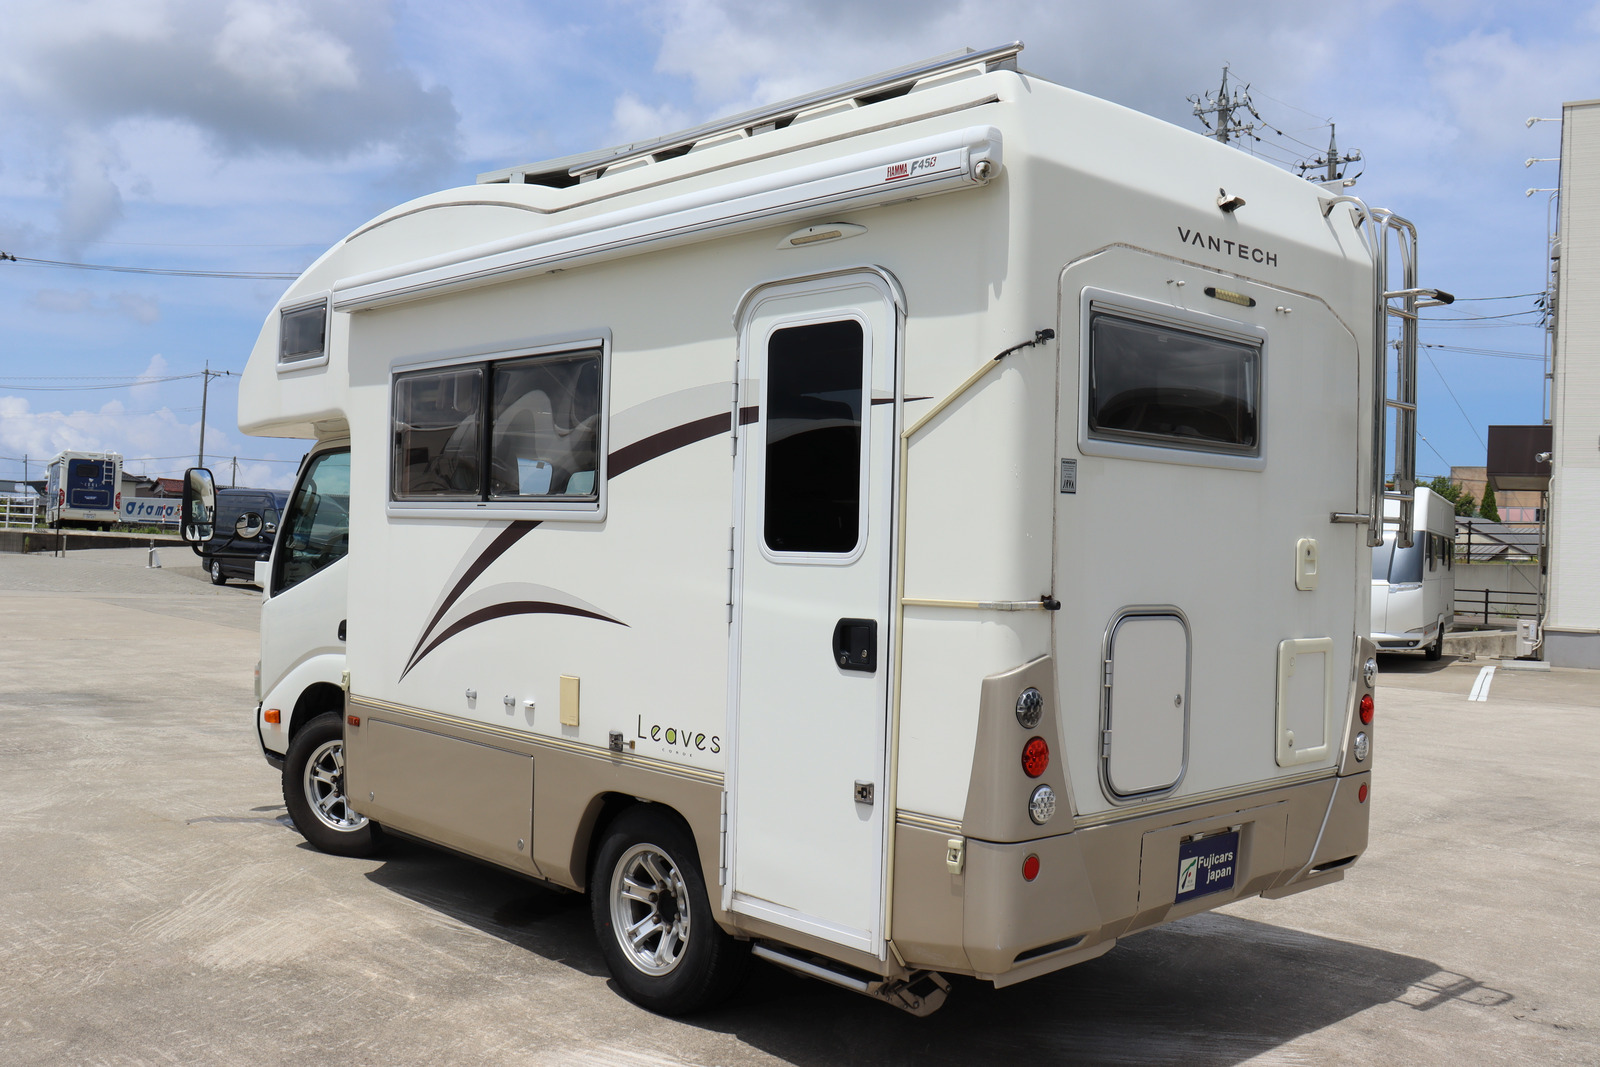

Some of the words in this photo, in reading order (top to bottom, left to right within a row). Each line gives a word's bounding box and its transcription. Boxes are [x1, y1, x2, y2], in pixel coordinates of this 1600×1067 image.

[887, 163, 908, 178] FIAMMA
[1178, 226, 1277, 267] VANTECH
[637, 713, 721, 754] Leaves
[1198, 851, 1233, 869] Fujicars
[1206, 866, 1232, 885] japan
